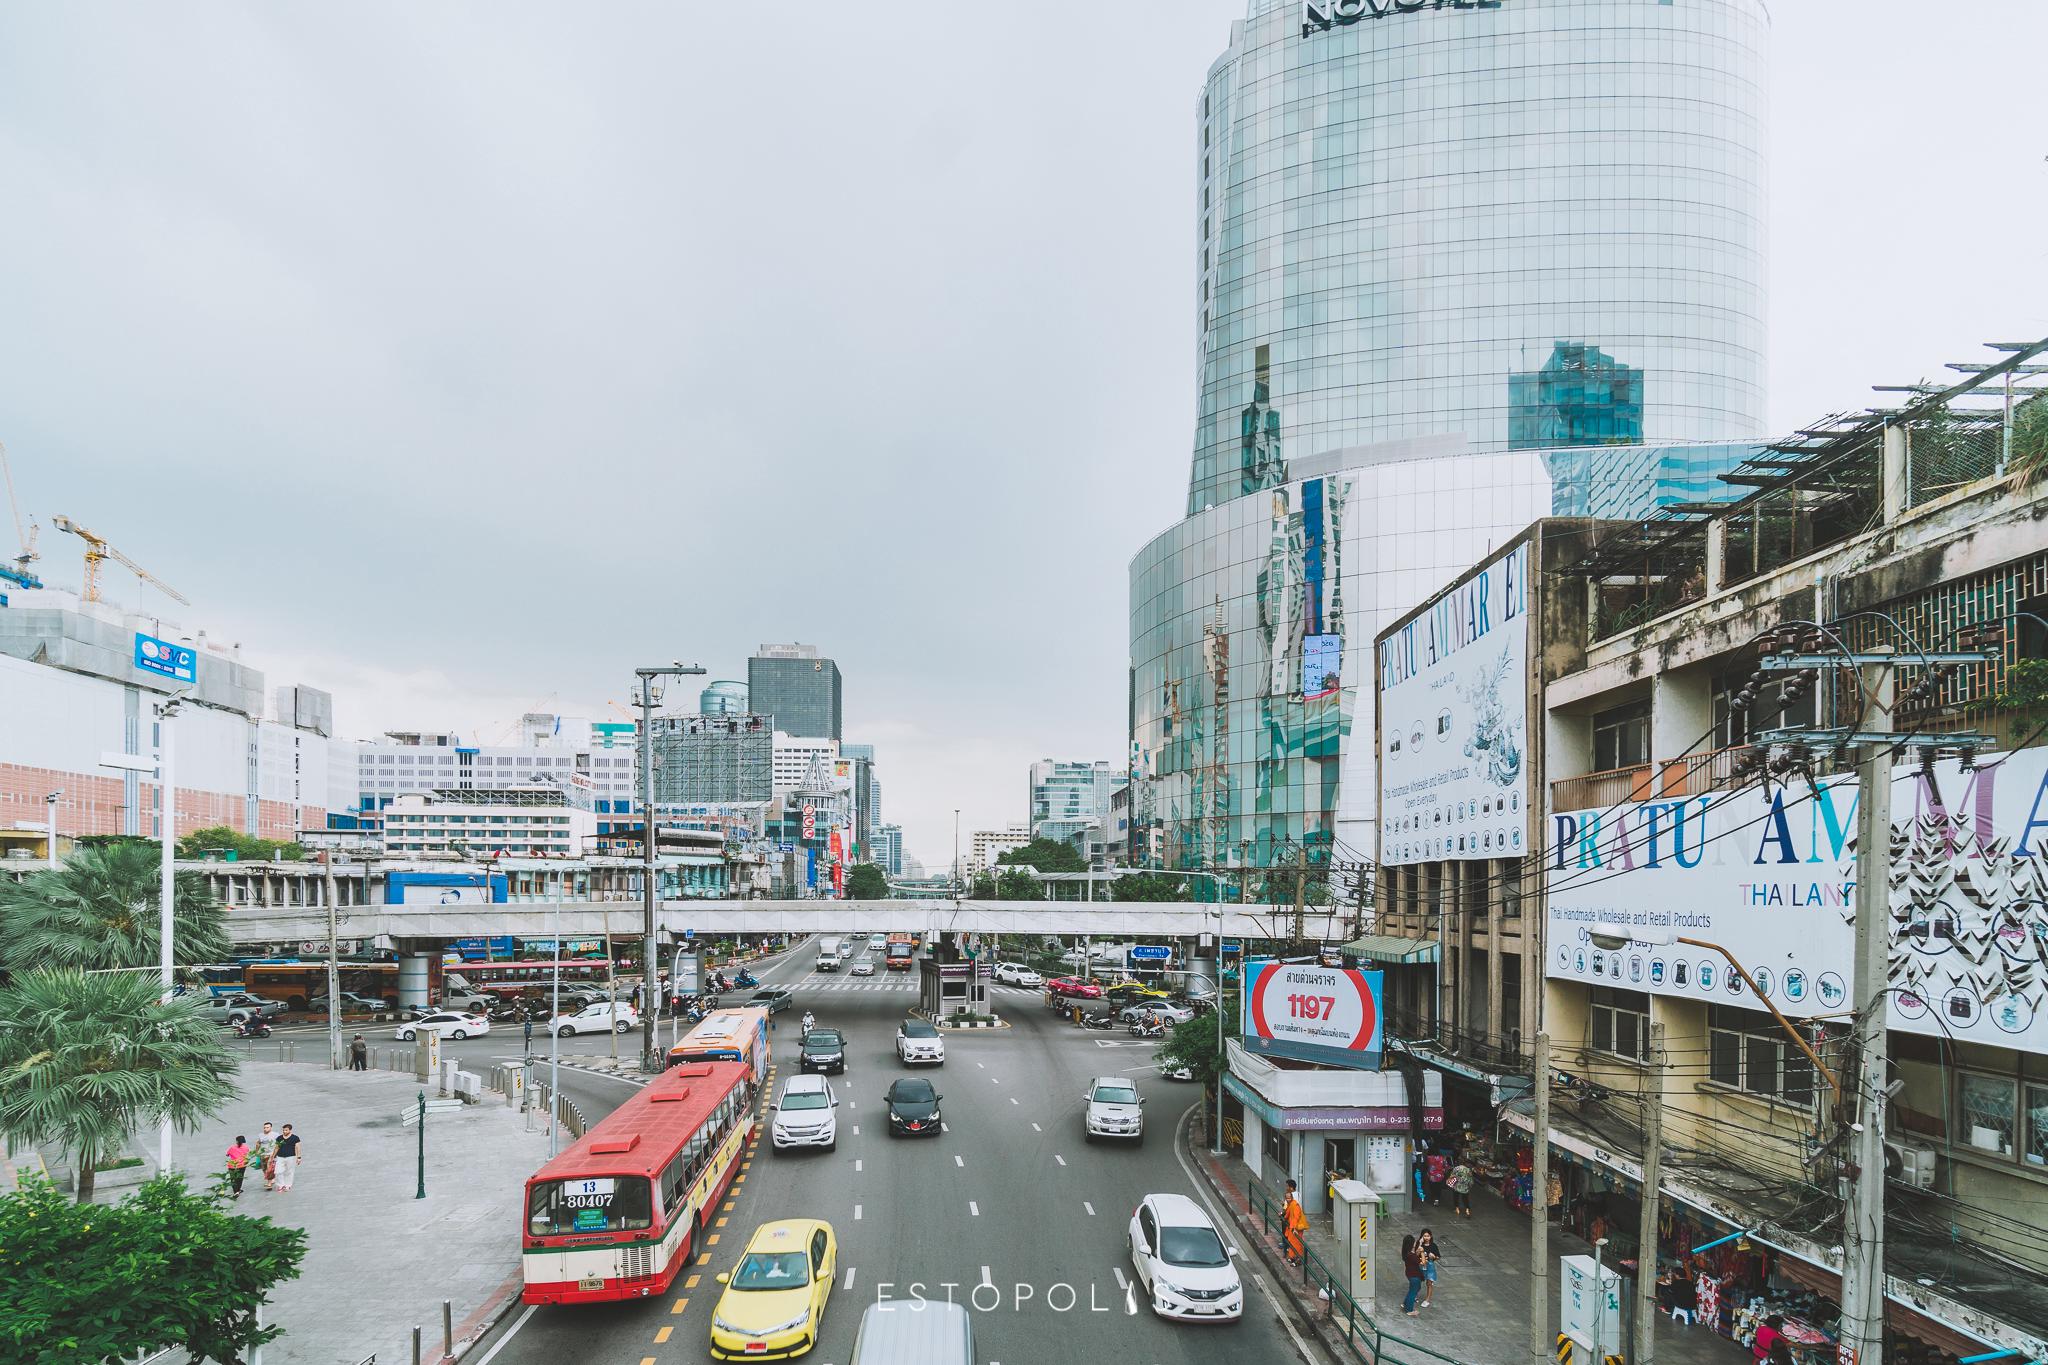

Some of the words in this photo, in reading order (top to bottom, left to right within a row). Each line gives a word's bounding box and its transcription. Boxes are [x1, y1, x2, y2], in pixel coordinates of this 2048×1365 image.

[1550, 906, 1563, 921] Thai
[1563, 907, 1596, 922] Handmade
[1597, 907, 1632, 925] Wholesale
[1632, 909, 1648, 926] and
[1649, 911, 1672, 927] Retail
[1673, 910, 1711, 929] Products
[1286, 969, 1336, 987] สายด่วนจราจร
[1287, 993, 1336, 1021] 1197
[582, 1181, 596, 1193] 13
